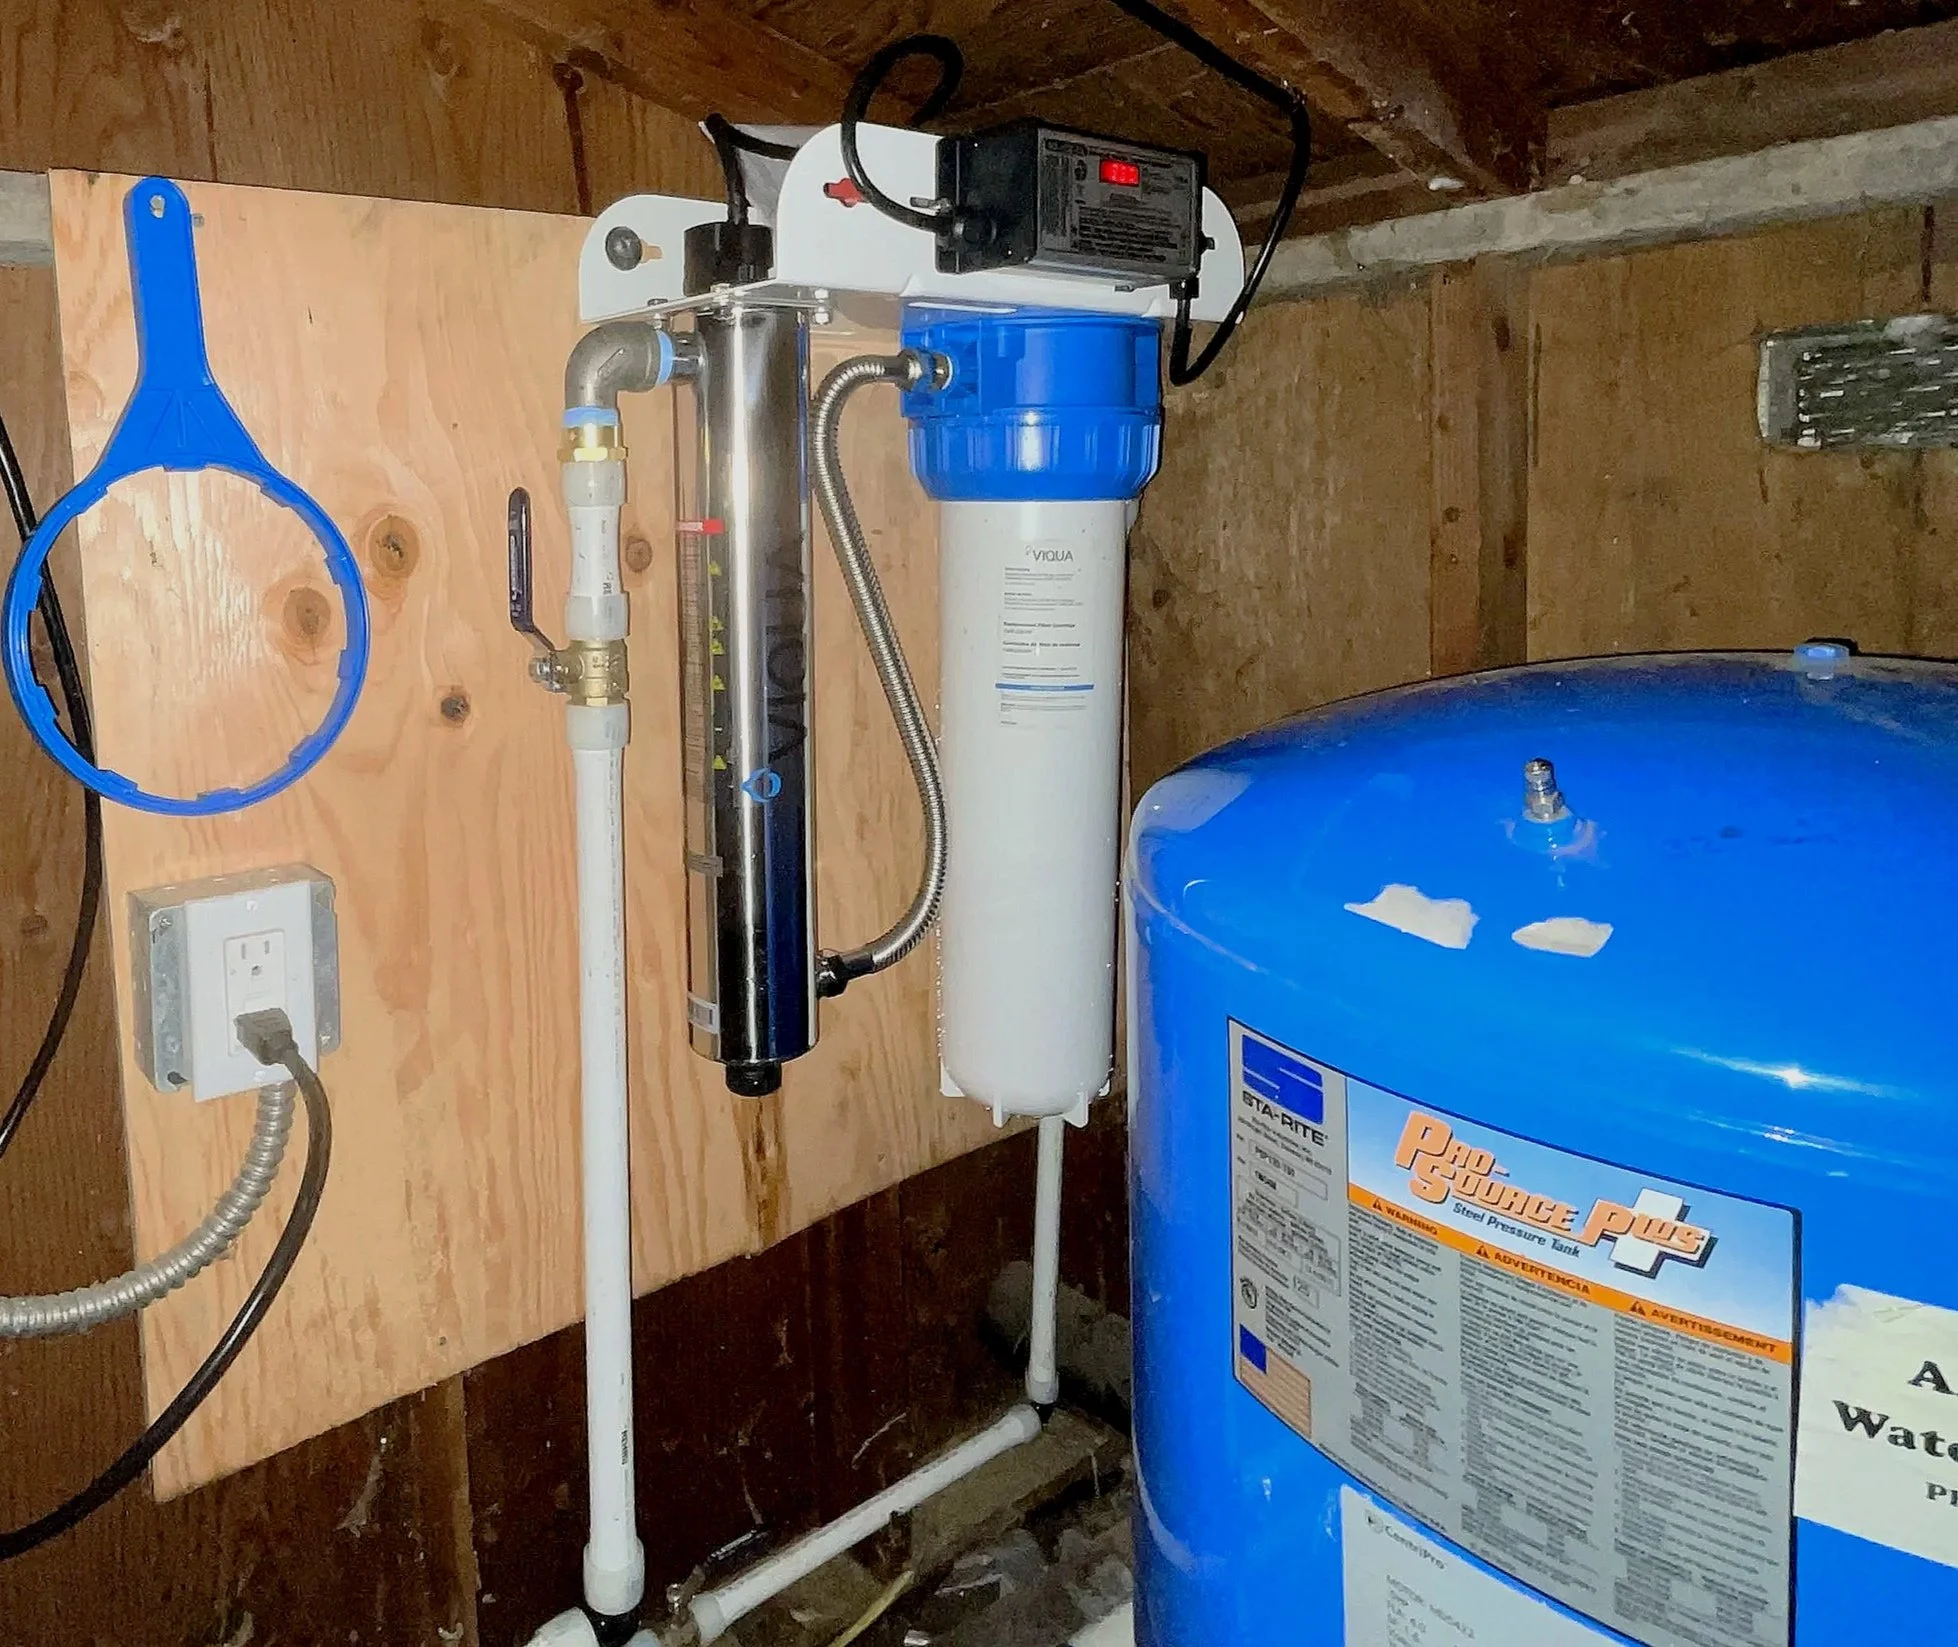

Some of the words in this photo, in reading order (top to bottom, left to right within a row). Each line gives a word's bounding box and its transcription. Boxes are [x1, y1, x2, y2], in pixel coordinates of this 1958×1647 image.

[1032, 549, 1074, 562] VIQUA
[1242, 1090, 1325, 1147] STA-RITE
[1385, 1206, 1438, 1236] WARNING
[1452, 1202, 1485, 1223] Steel
[1486, 1215, 1547, 1247] Pressure
[1551, 1238, 1581, 1259] Tank
[1494, 1252, 1591, 1295] ADVERTENCIA
[1650, 1308, 1777, 1354] AVERTISSEMENT
